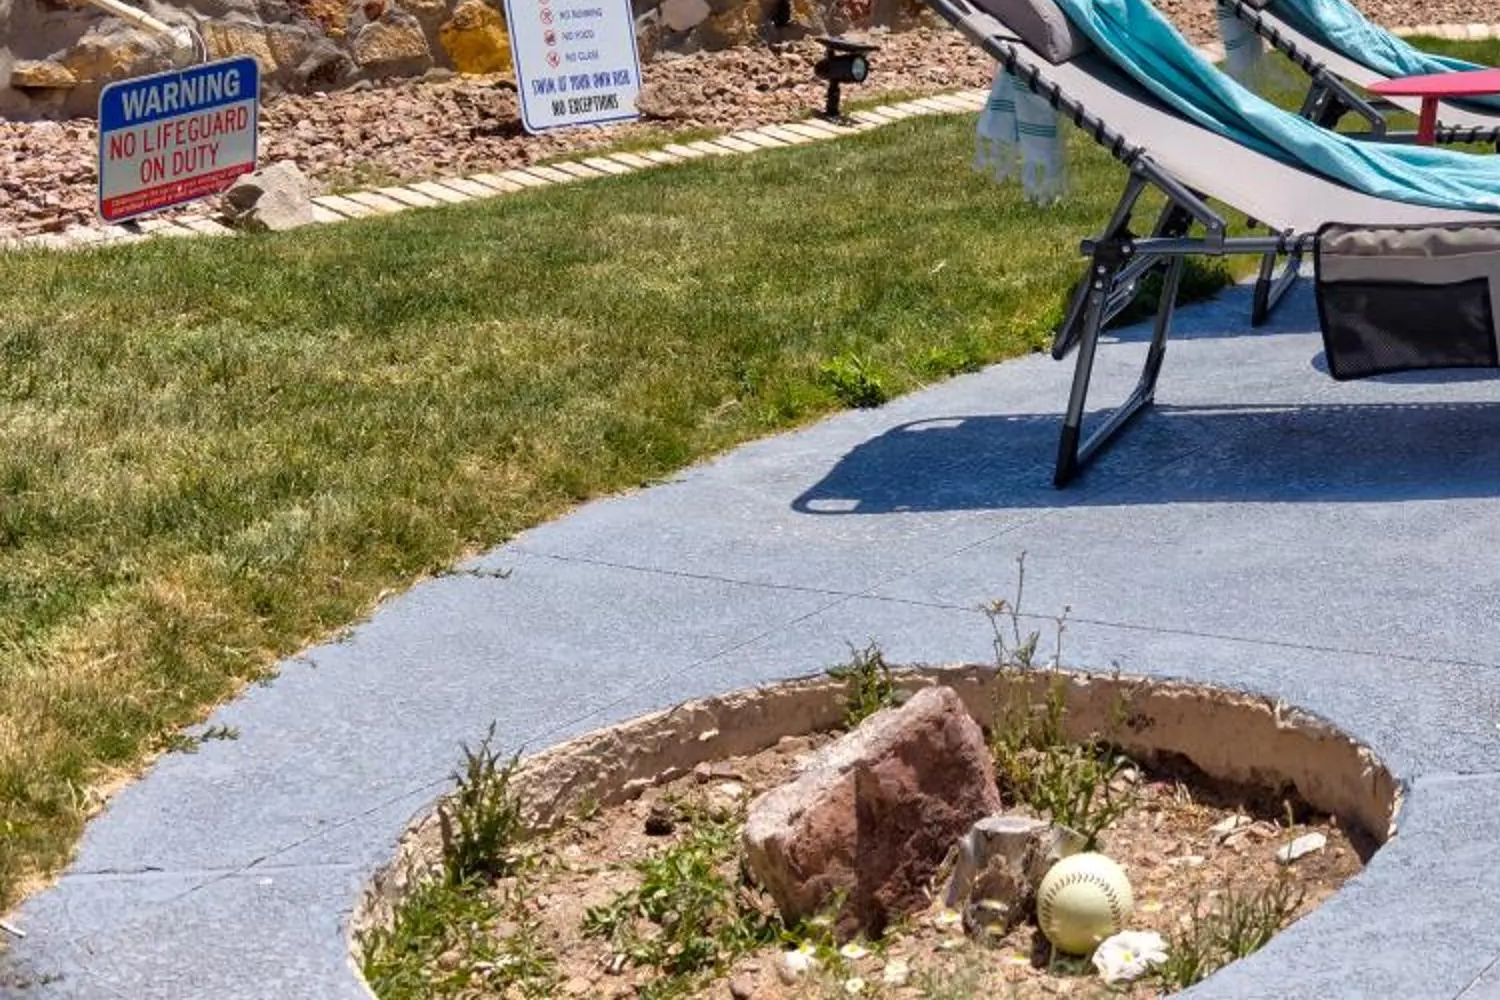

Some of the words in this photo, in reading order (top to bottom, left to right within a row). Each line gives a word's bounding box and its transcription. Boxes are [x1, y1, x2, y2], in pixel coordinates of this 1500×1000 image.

[121, 68, 241, 121] WARNING
[552, 99, 566, 116] NO
[567, 92, 619, 115] EXCEPTIONS
[109, 131, 136, 161] NO
[143, 105, 249, 153] LIFEGUARD
[140, 154, 165, 185] ON
[172, 142, 220, 176] DUTY
